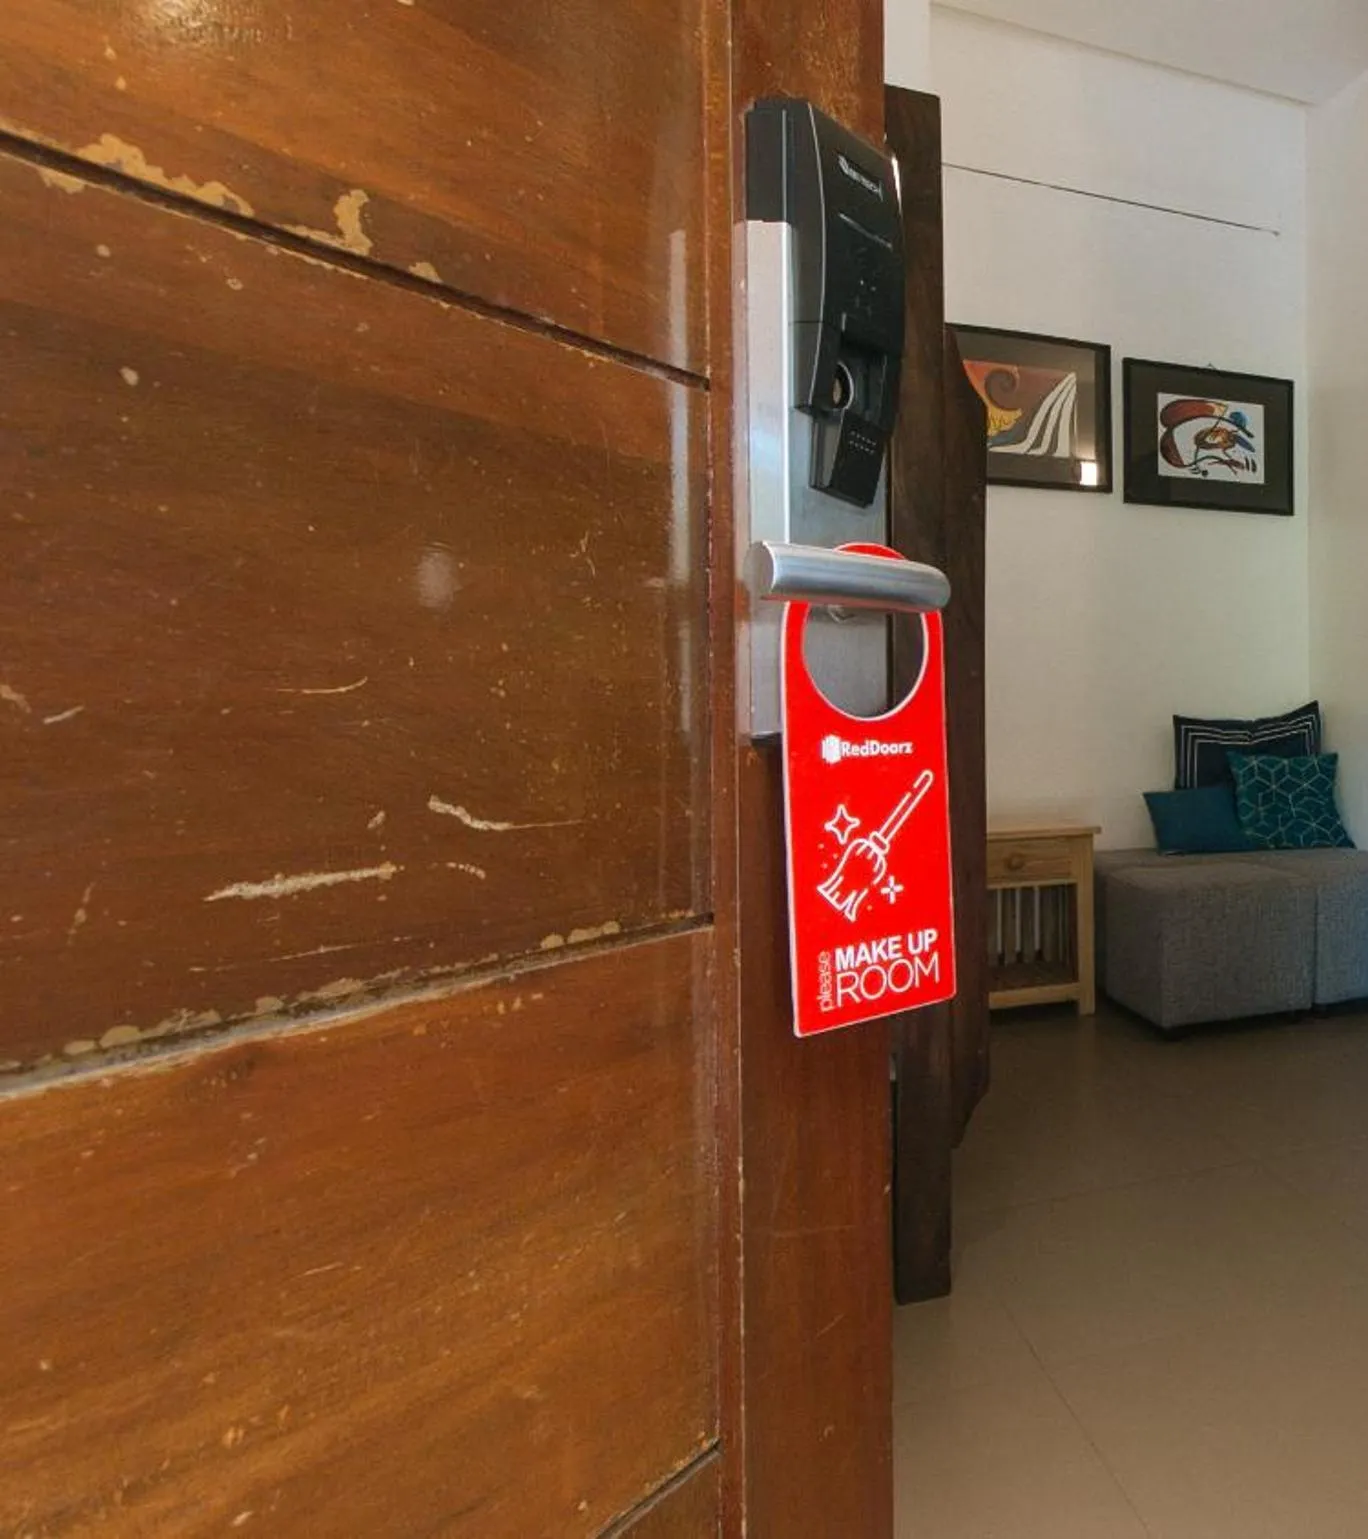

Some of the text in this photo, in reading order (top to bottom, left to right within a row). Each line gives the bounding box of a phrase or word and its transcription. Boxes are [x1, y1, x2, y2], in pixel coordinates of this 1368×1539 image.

[841, 738, 913, 758] RedDoorz
[835, 928, 938, 972] MAKE UP
[817, 951, 835, 1012] please
[836, 951, 940, 1008] ROOM
